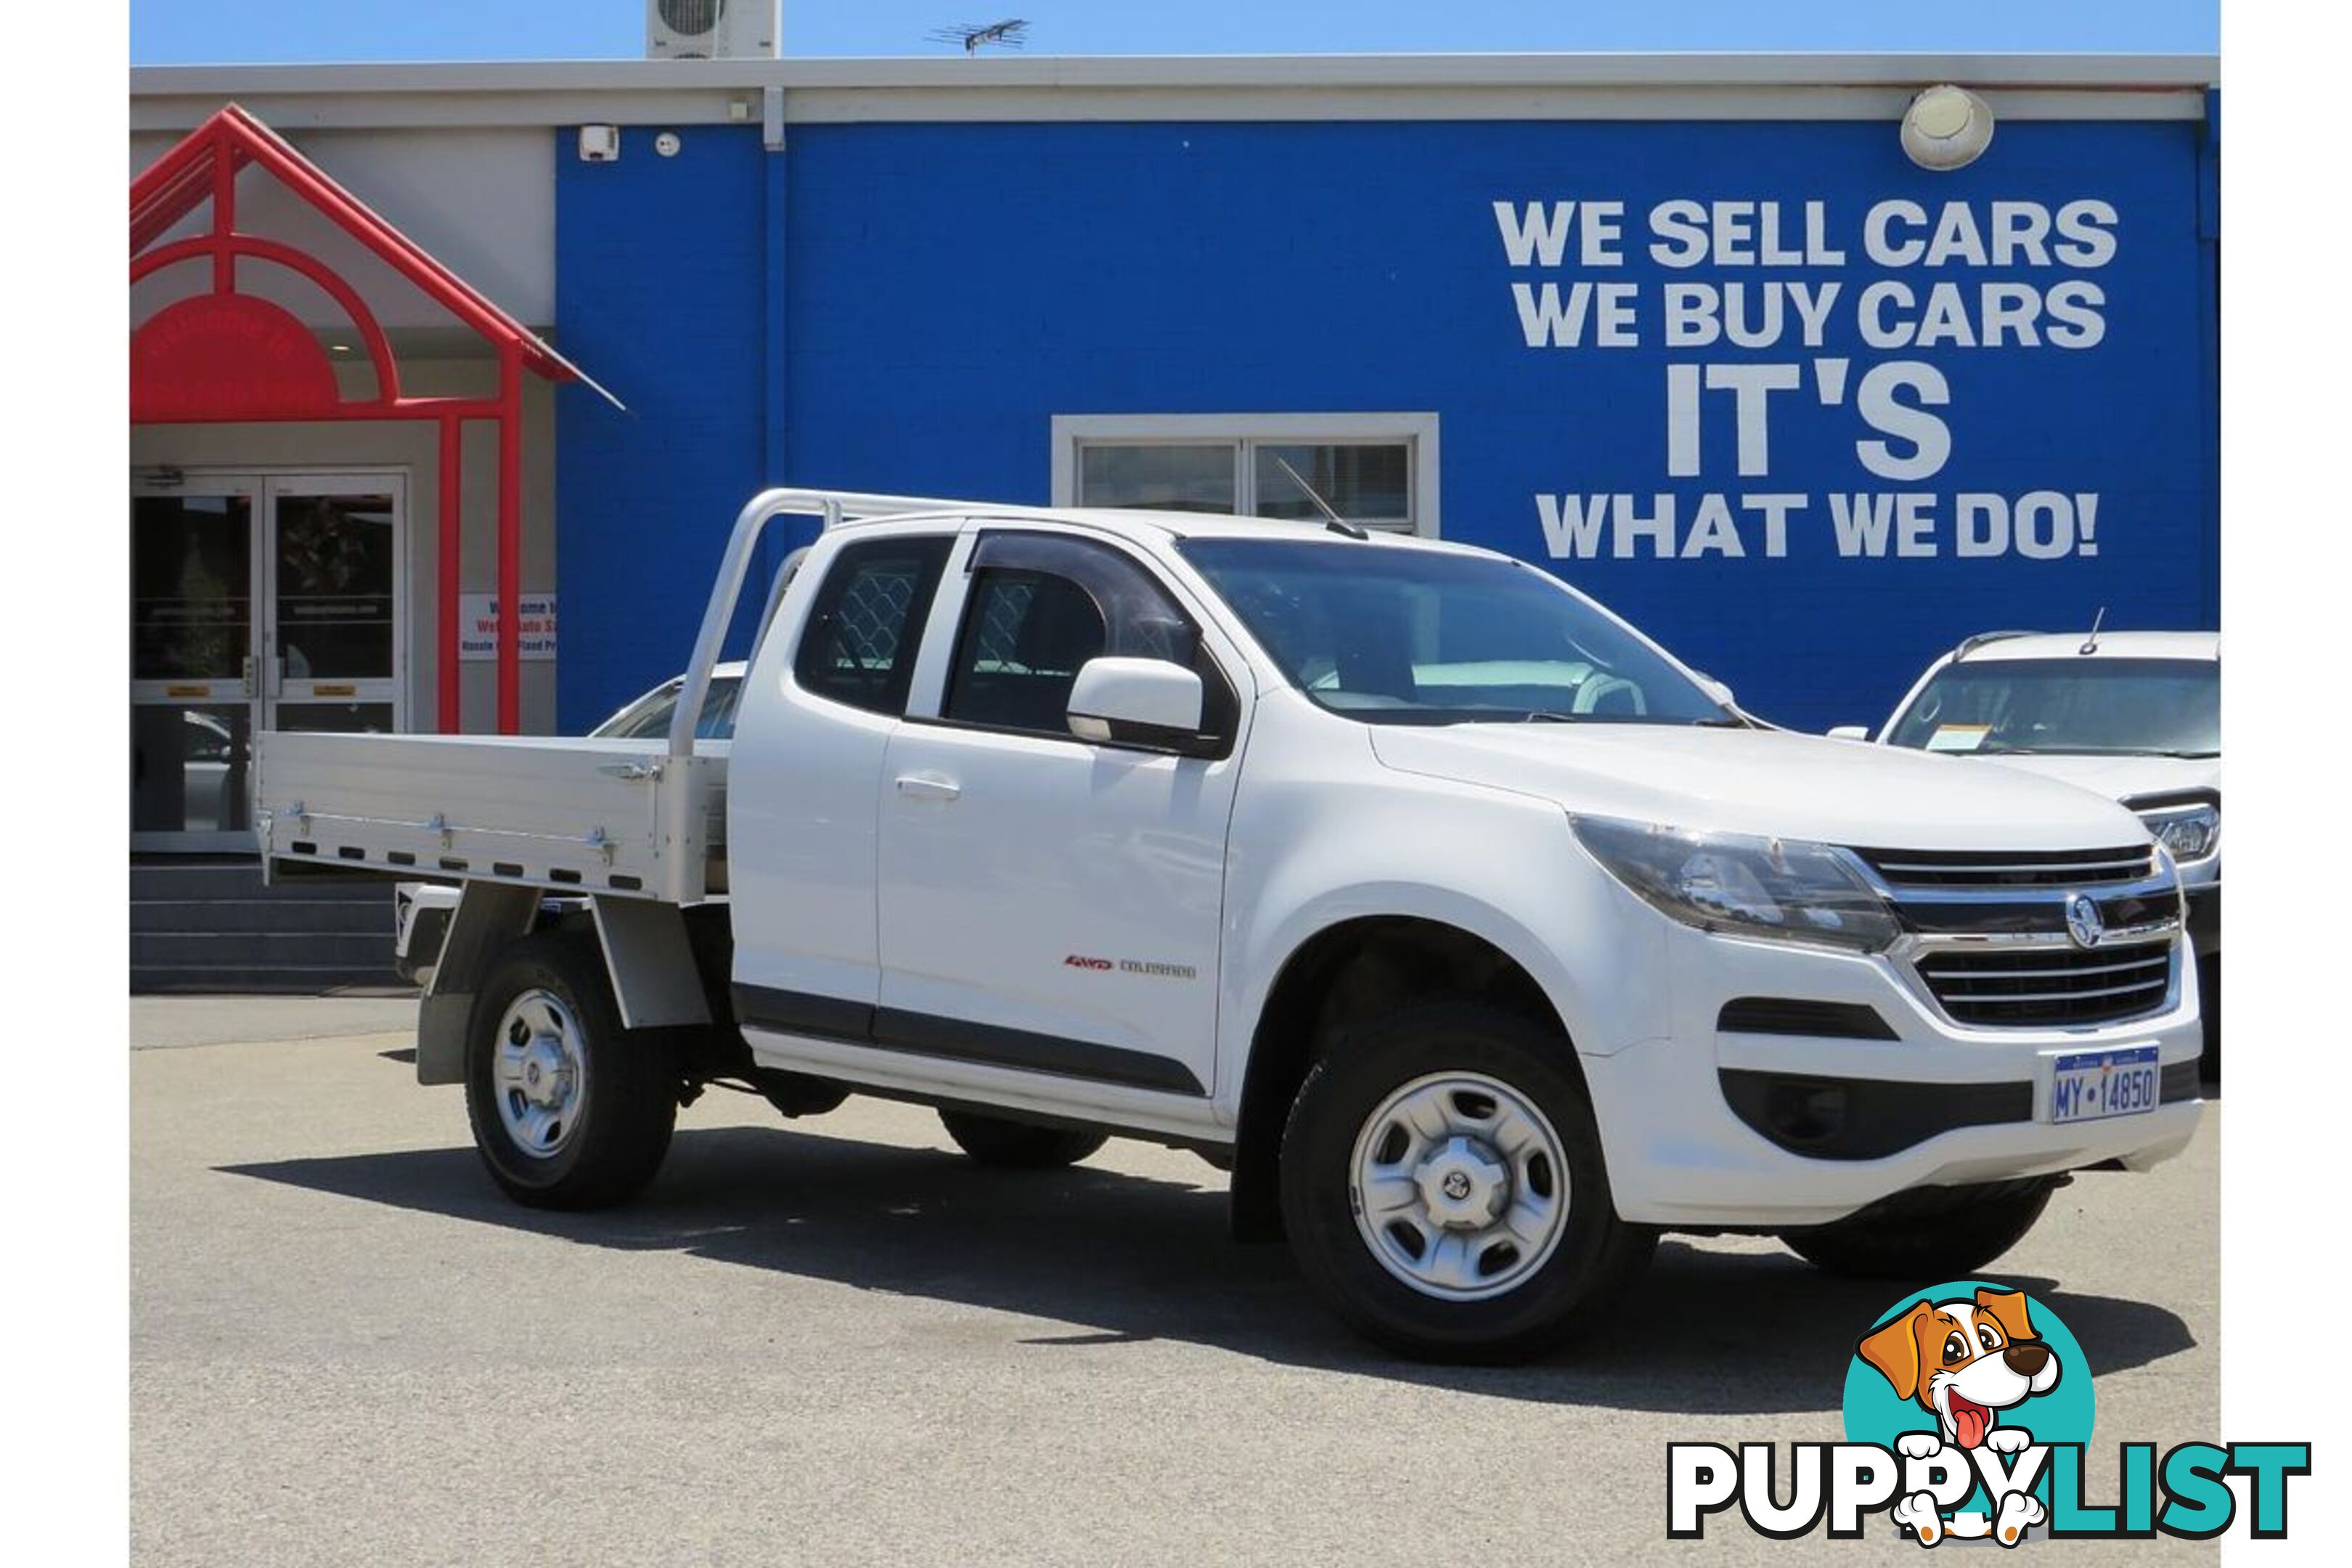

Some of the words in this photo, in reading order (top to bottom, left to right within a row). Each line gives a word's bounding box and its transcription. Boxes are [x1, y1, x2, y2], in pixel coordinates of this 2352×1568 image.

[1493, 202, 1623, 266] WE
[1650, 200, 1845, 267] SELL
[1865, 200, 2117, 267] CARS
[1512, 283, 1638, 346] WE
[1665, 282, 1840, 347] BUY
[1859, 281, 2104, 348] CARS
[1668, 359, 1951, 480] IT'S
[1536, 494, 1807, 558] WHAT
[1829, 494, 1936, 556] WE
[1957, 491, 2097, 558] DO!
